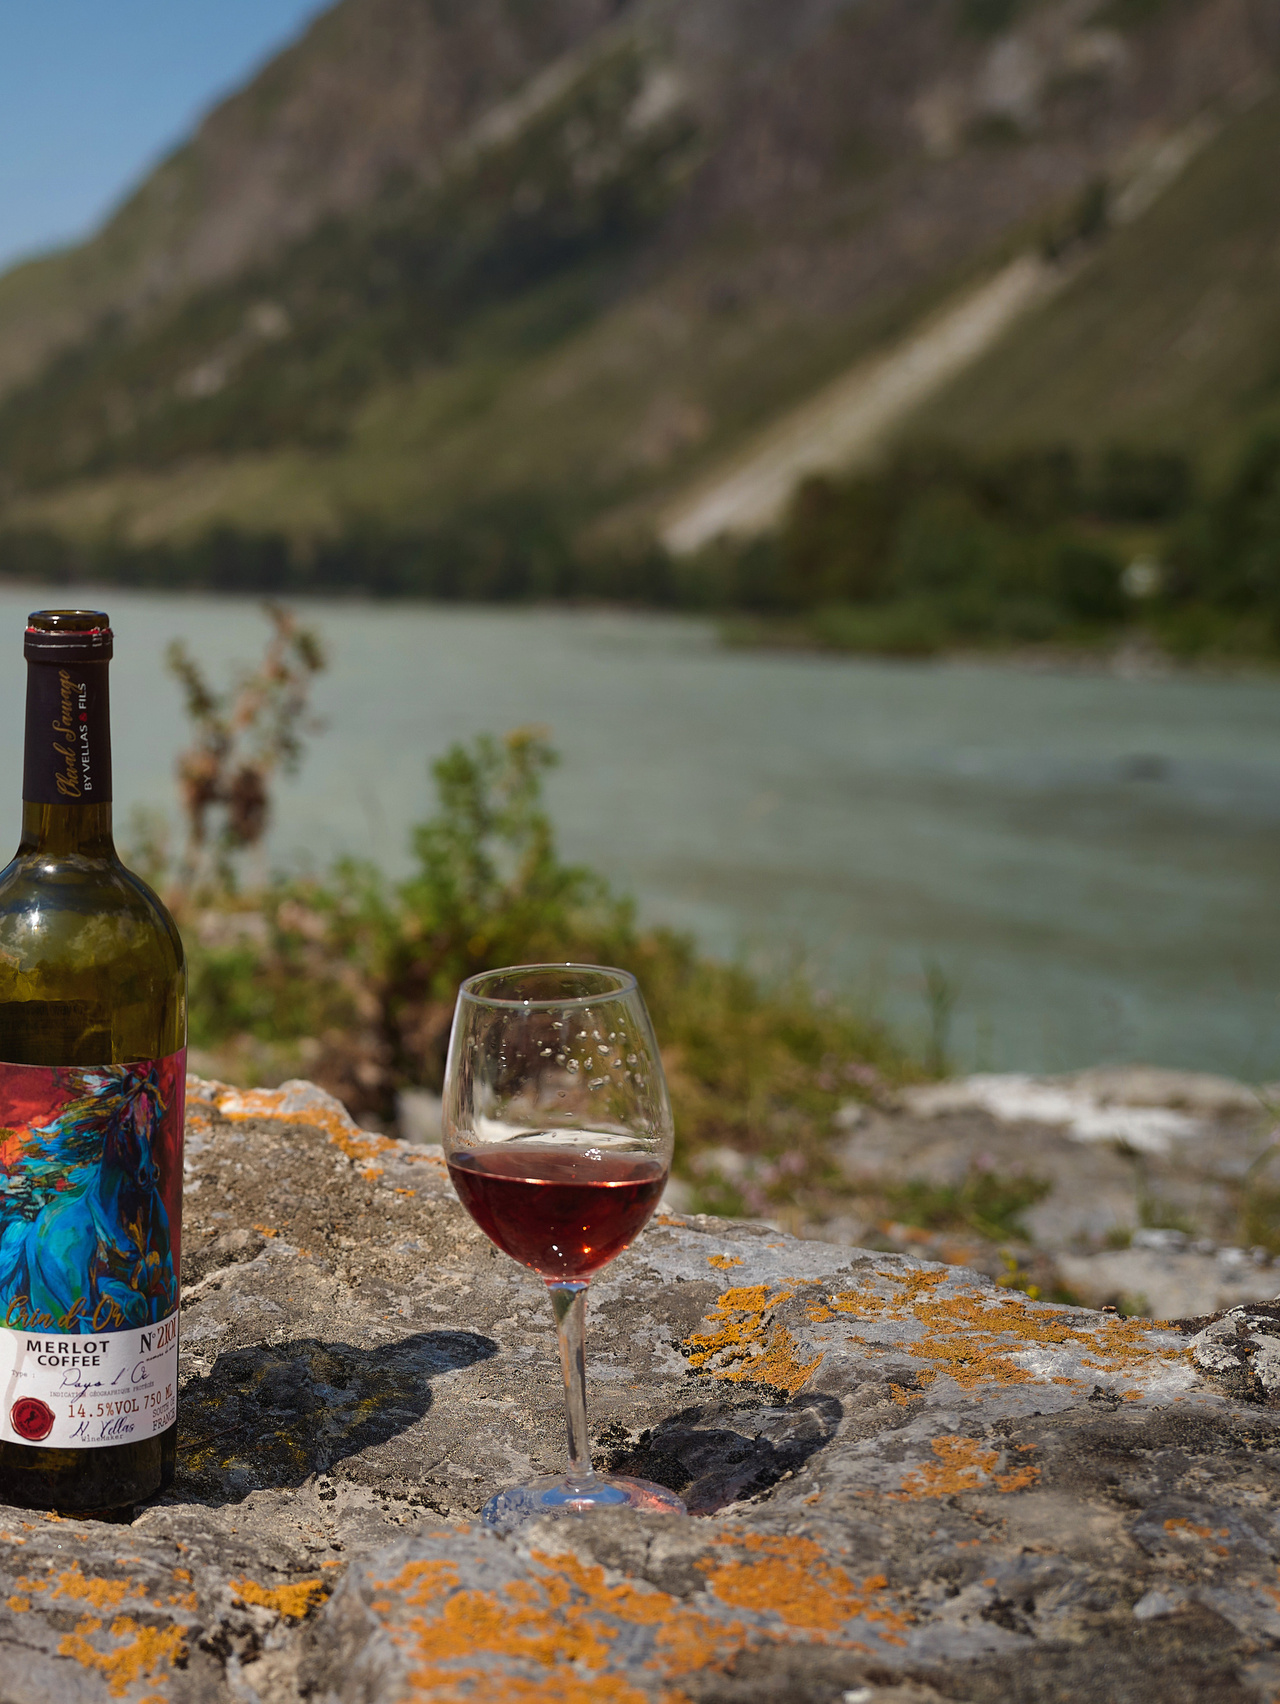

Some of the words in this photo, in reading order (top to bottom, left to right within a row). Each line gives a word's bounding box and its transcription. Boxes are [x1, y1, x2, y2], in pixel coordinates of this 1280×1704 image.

[52, 669, 82, 742] Sauvage
[78, 683, 87, 709] FILS
[80, 725, 91, 772] VELLAS
[53, 742, 81, 797] Cheval
[83, 774, 92, 790] BY
[5, 1294, 55, 1328] Crin
[26, 1339, 110, 1354] MERLOT
[37, 1354, 101, 1367] COFFEE
[59, 1367, 105, 1404] Pays
[144, 1391, 162, 1410] 750
